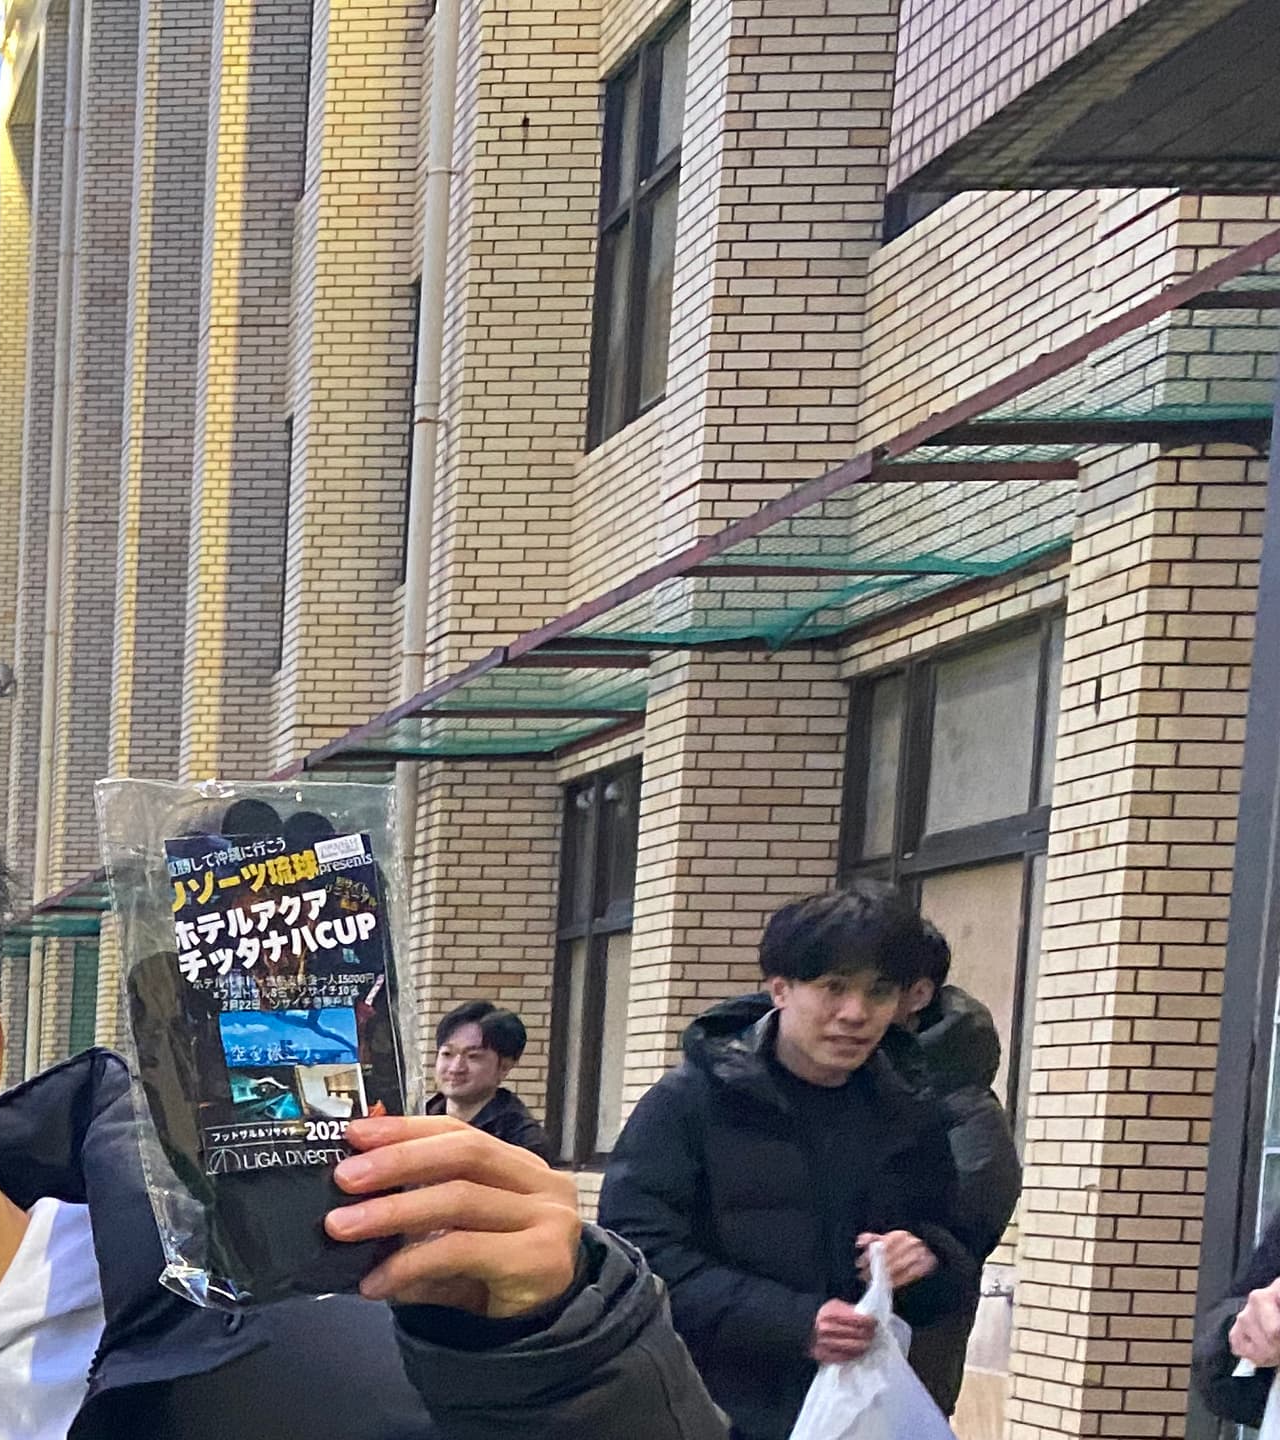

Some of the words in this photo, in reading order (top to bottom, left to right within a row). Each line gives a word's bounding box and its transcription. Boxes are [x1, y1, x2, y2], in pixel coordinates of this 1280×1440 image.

[319, 852, 374, 875] presents
[175, 888, 328, 951] ホテルアクア
[178, 912, 377, 983] チッタナハCUP
